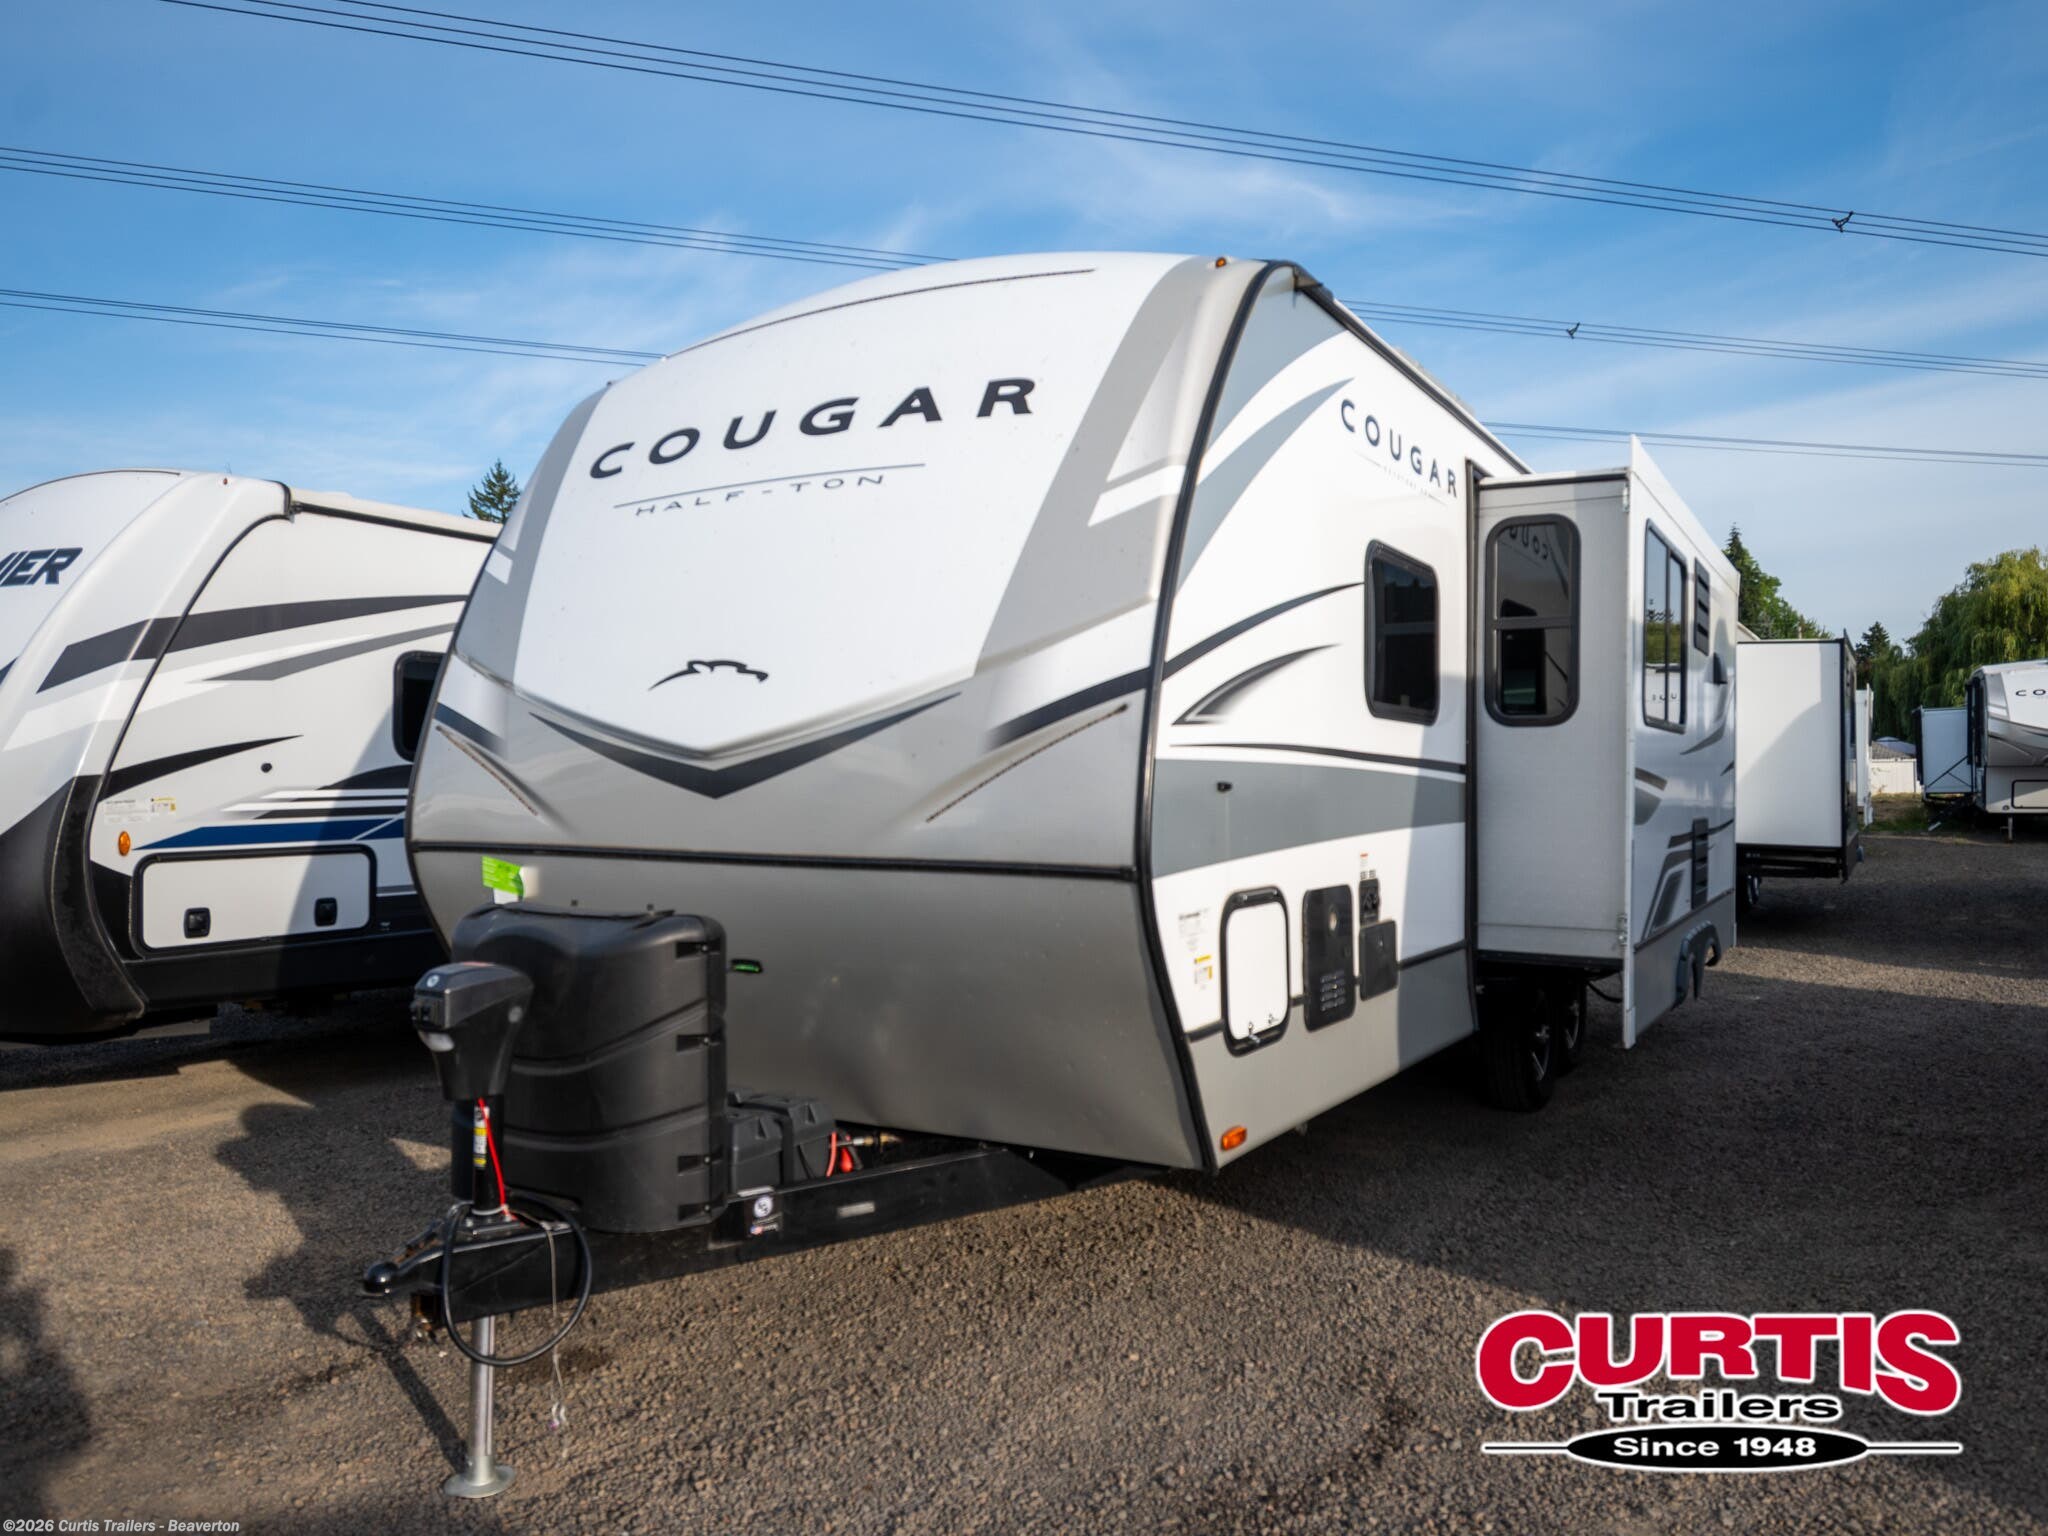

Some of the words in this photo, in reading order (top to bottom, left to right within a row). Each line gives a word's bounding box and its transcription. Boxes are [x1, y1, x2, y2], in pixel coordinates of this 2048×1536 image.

[589, 378, 1036, 480] COUGAR
[1341, 398, 1457, 498] COUGAR
[635, 474, 886, 517] HALF-TON
[0, 547, 83, 587] IER
